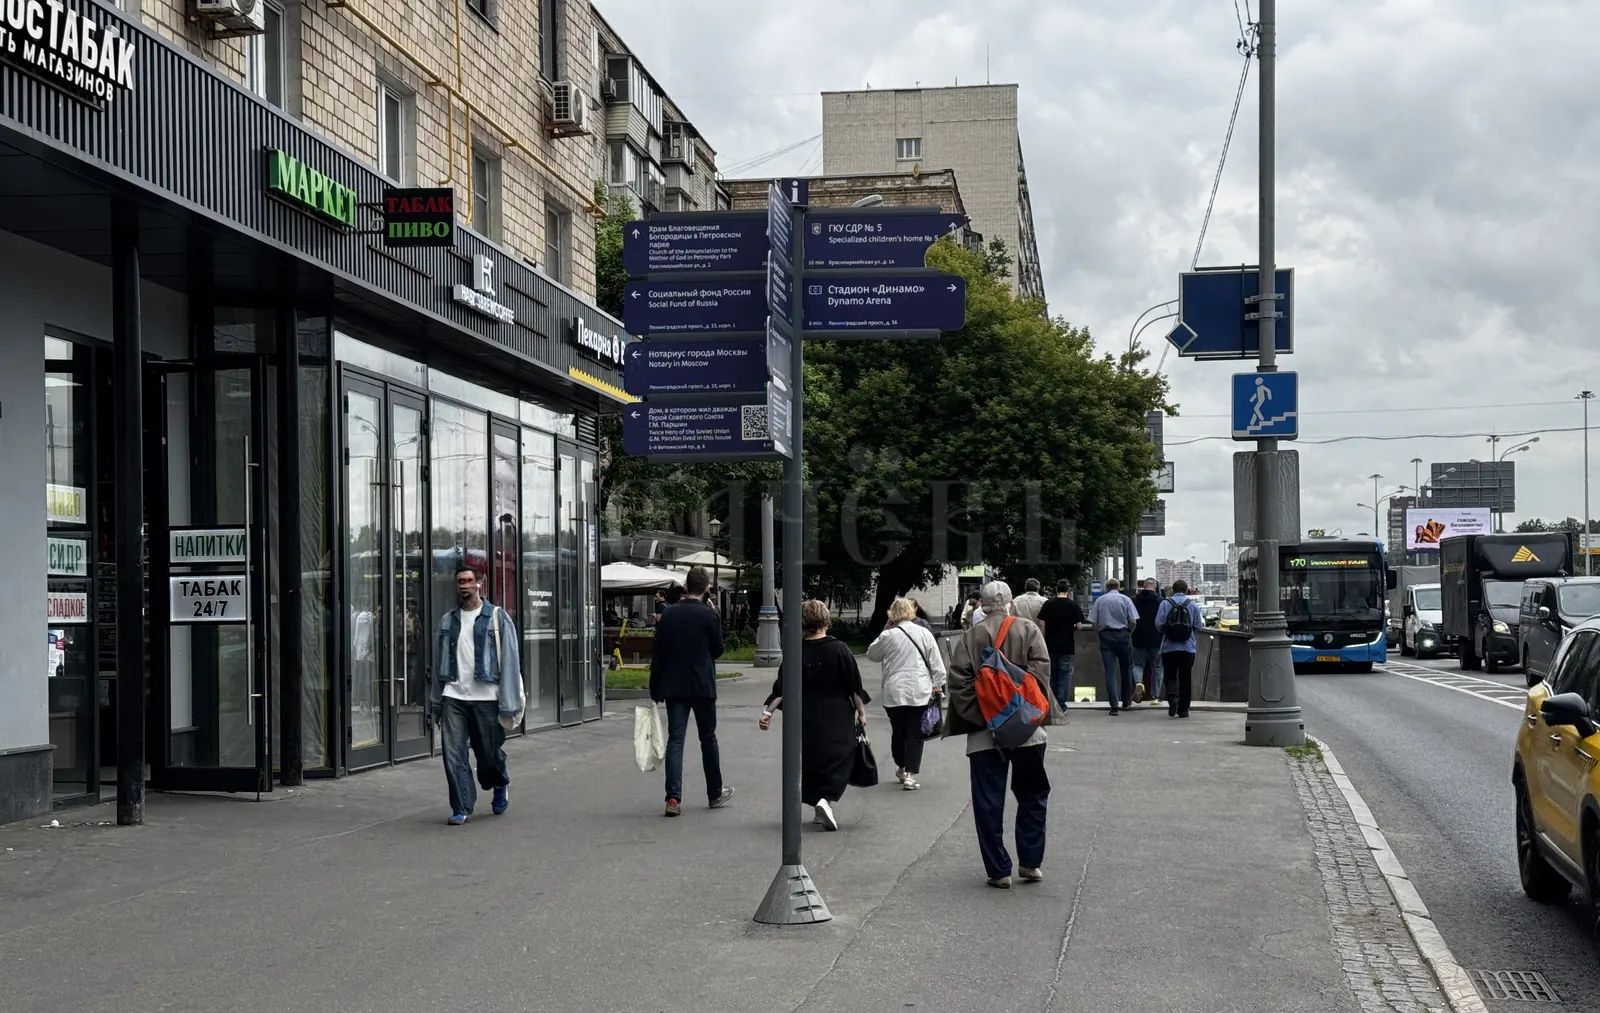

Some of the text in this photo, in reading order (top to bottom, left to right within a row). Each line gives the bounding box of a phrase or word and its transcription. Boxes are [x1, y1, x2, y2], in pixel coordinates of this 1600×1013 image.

[0, 0, 135, 90] ОСТАБАК
[23, 39, 114, 102] МАГАЗИНОВ
[277, 149, 358, 227] МАРКЕТ
[385, 196, 453, 213] ТАБАК
[388, 221, 450, 238] ПИВО
[648, 225, 668, 233] Храм
[648, 233, 693, 241] Богородицы
[828, 224, 883, 233] ГКУ СДР № 5
[828, 236, 868, 244] Specialized
[648, 288, 752, 299] Социальный фонд России
[828, 285, 925, 295] Стадион «Динамо»
[828, 297, 892, 308] Dynamo Arena
[578, 316, 612, 360] Пекарня
[648, 350, 686, 359] Нотариус
[688, 350, 715, 358] города
[175, 534, 246, 556] НАПИТКИ
[49, 543, 82, 573] СИДР
[180, 580, 241, 597] ТАБАК
[48, 597, 86, 619] СЛАДКОЕ
[193, 600, 228, 616] 24/7
